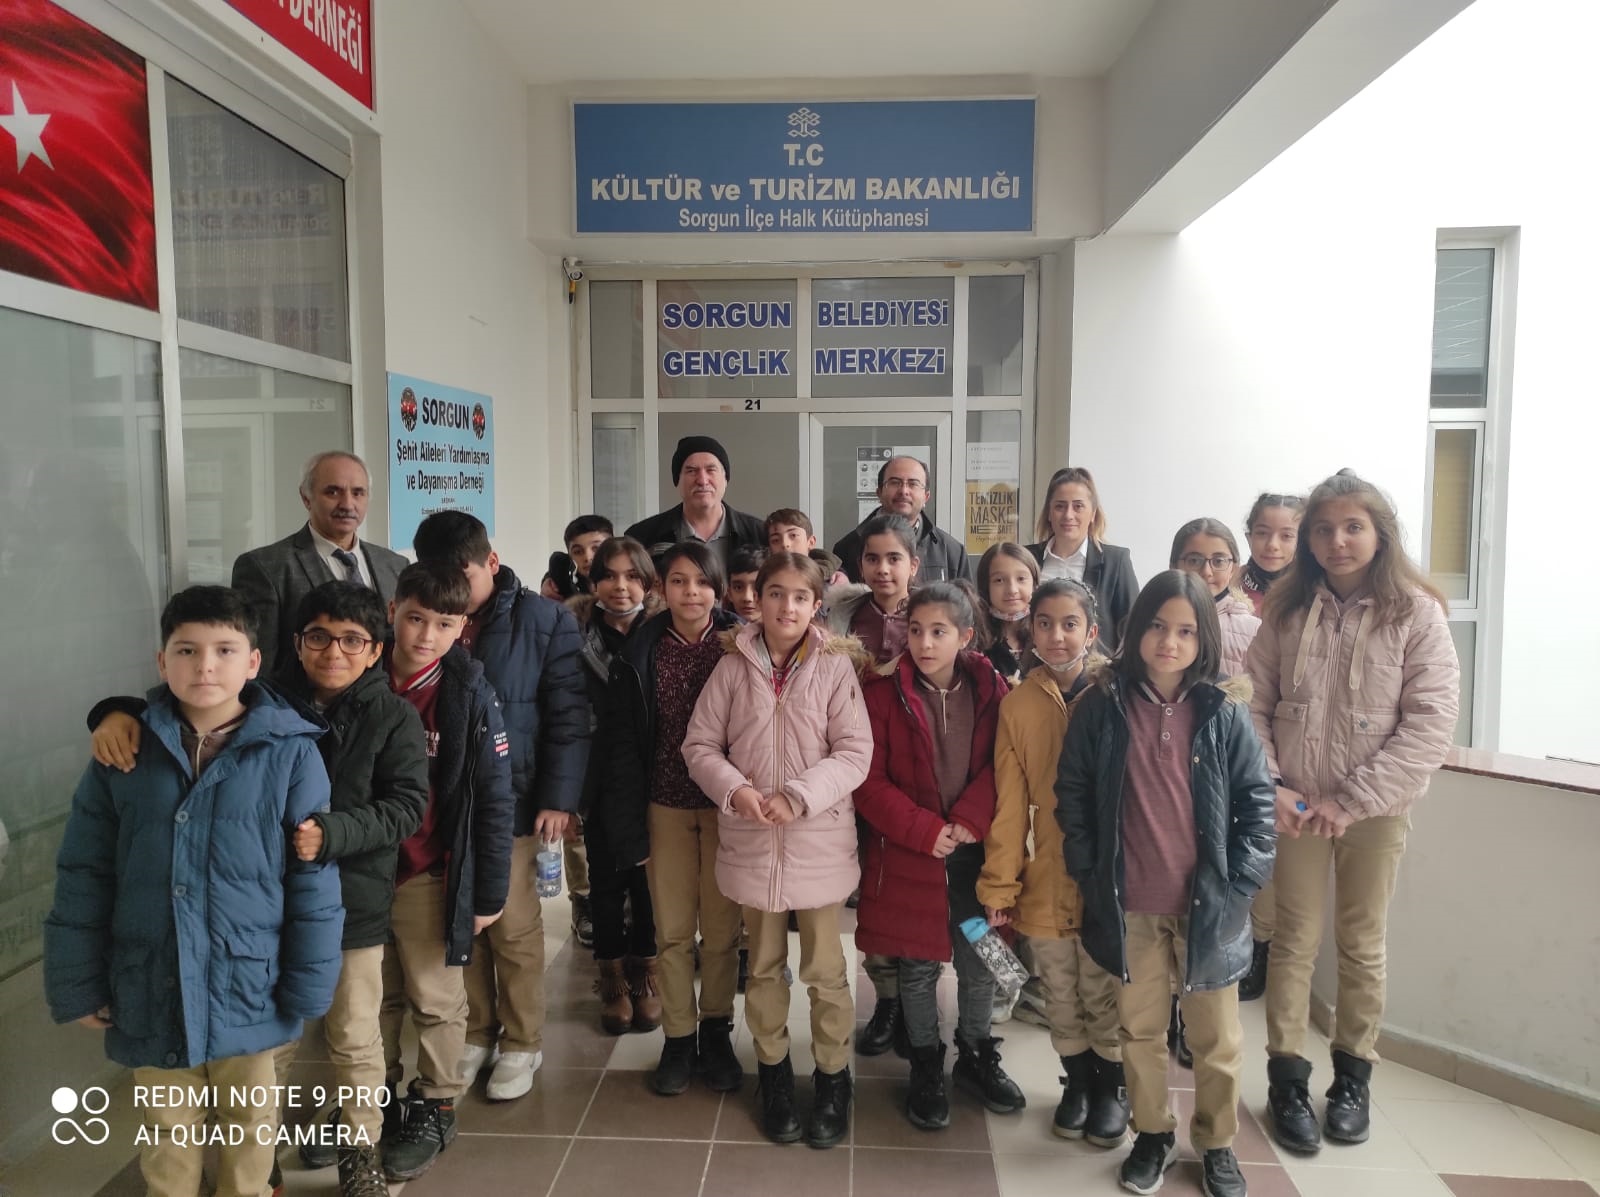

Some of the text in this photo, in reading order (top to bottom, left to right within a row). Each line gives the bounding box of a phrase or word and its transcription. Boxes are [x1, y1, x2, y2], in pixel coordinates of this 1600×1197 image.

[783, 143, 824, 166] T.C
[591, 170, 1020, 201] KÜLTÜR ve TURİZM BAKANLIĞI
[679, 204, 929, 231] Sorgun İlçe Halk Kütüphanesi
[663, 302, 792, 329] SORGUN
[422, 397, 470, 430] SORGUN
[744, 399, 761, 411] 21
[397, 439, 490, 470] Şehit Aileleri Yardımlaşma
[406, 470, 485, 495] ve Dayanışma Derneği
[970, 506, 1015, 524] MASKE
